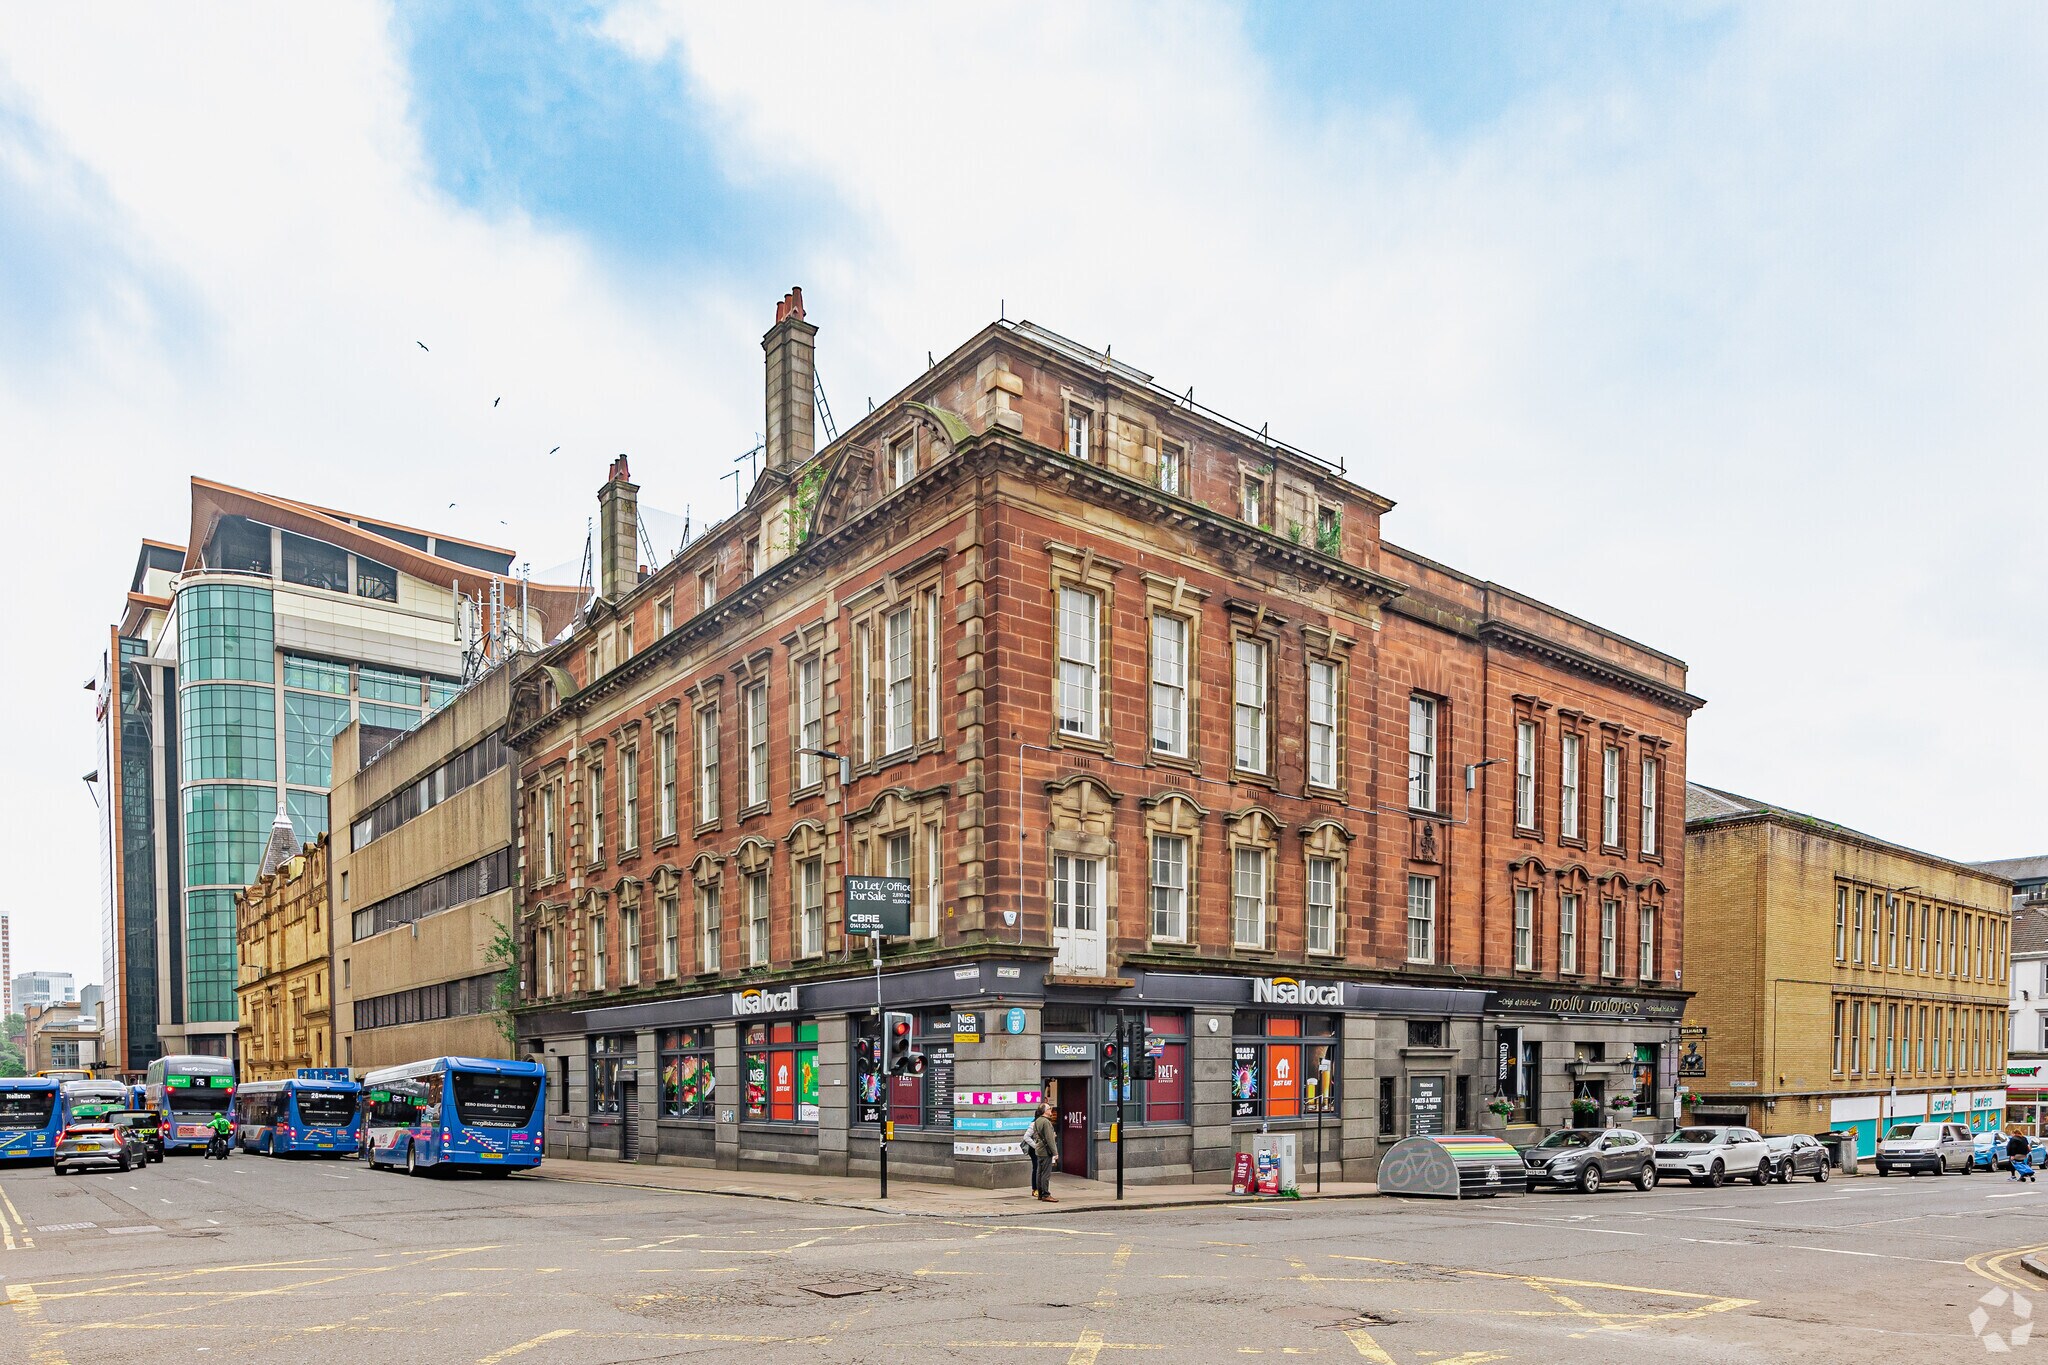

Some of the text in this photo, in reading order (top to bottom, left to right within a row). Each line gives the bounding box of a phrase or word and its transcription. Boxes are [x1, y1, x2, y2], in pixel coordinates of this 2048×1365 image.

[850, 880, 864, 890] To
[850, 891, 886, 901] For Sale
[850, 914, 880, 923] CBRE
[958, 1013, 976, 1024] Nisa
[958, 1024, 976, 1032] local
[1499, 1042, 1509, 1080] GUINNESS
[1158, 1064, 1174, 1078] PRET
[1974, 1094, 1992, 1108] savers
[1068, 1112, 1082, 1124] PRET
